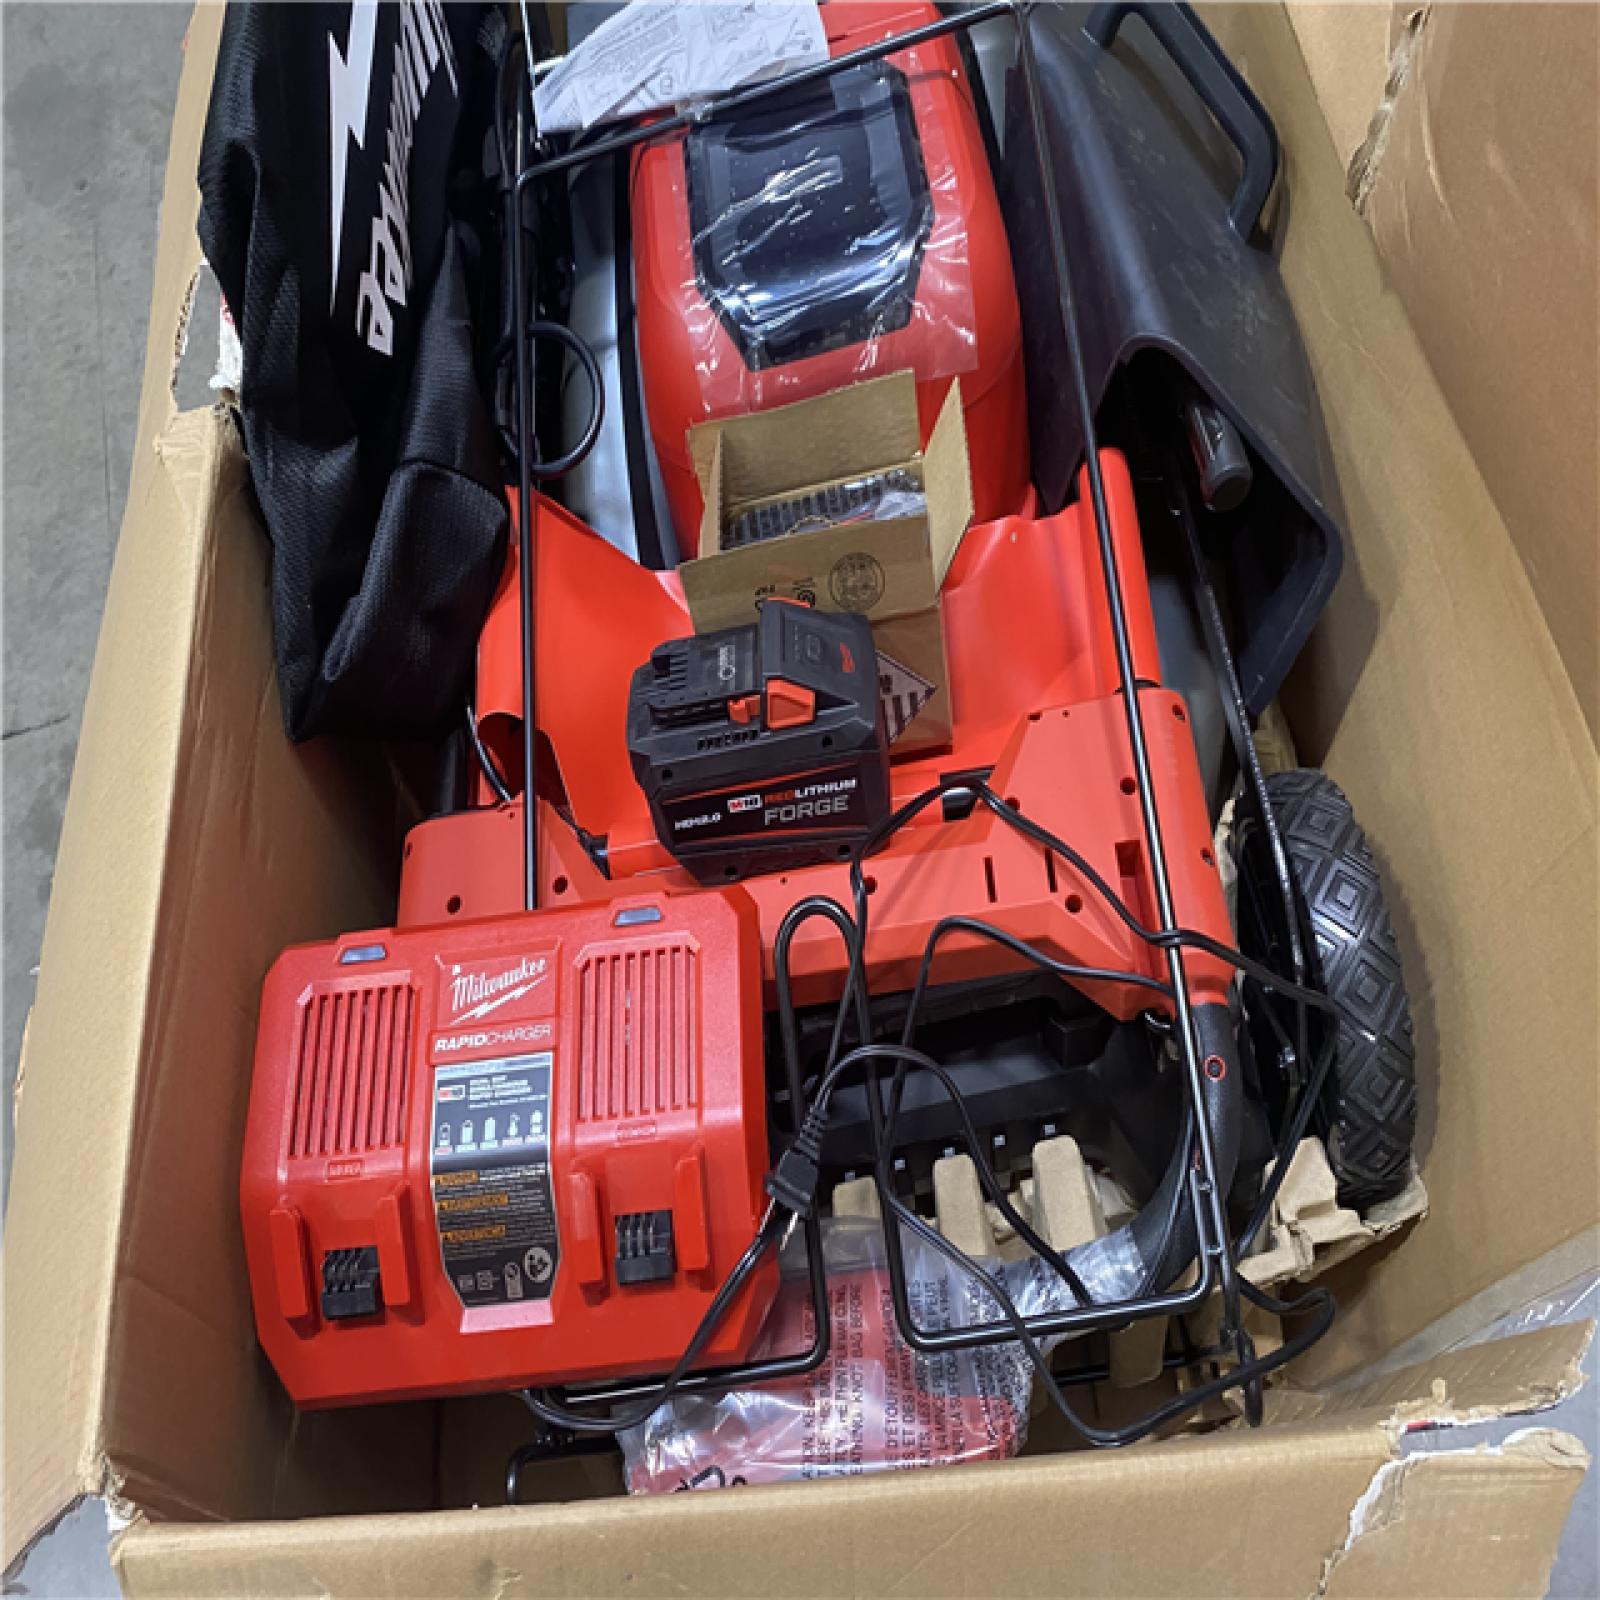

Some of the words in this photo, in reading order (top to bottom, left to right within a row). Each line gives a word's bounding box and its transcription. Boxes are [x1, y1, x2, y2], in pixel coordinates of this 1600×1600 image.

[765, 778, 856, 804] REDLITHIUM
[764, 795, 849, 826] FORGE
[450, 957, 546, 1013] Milwaukee
